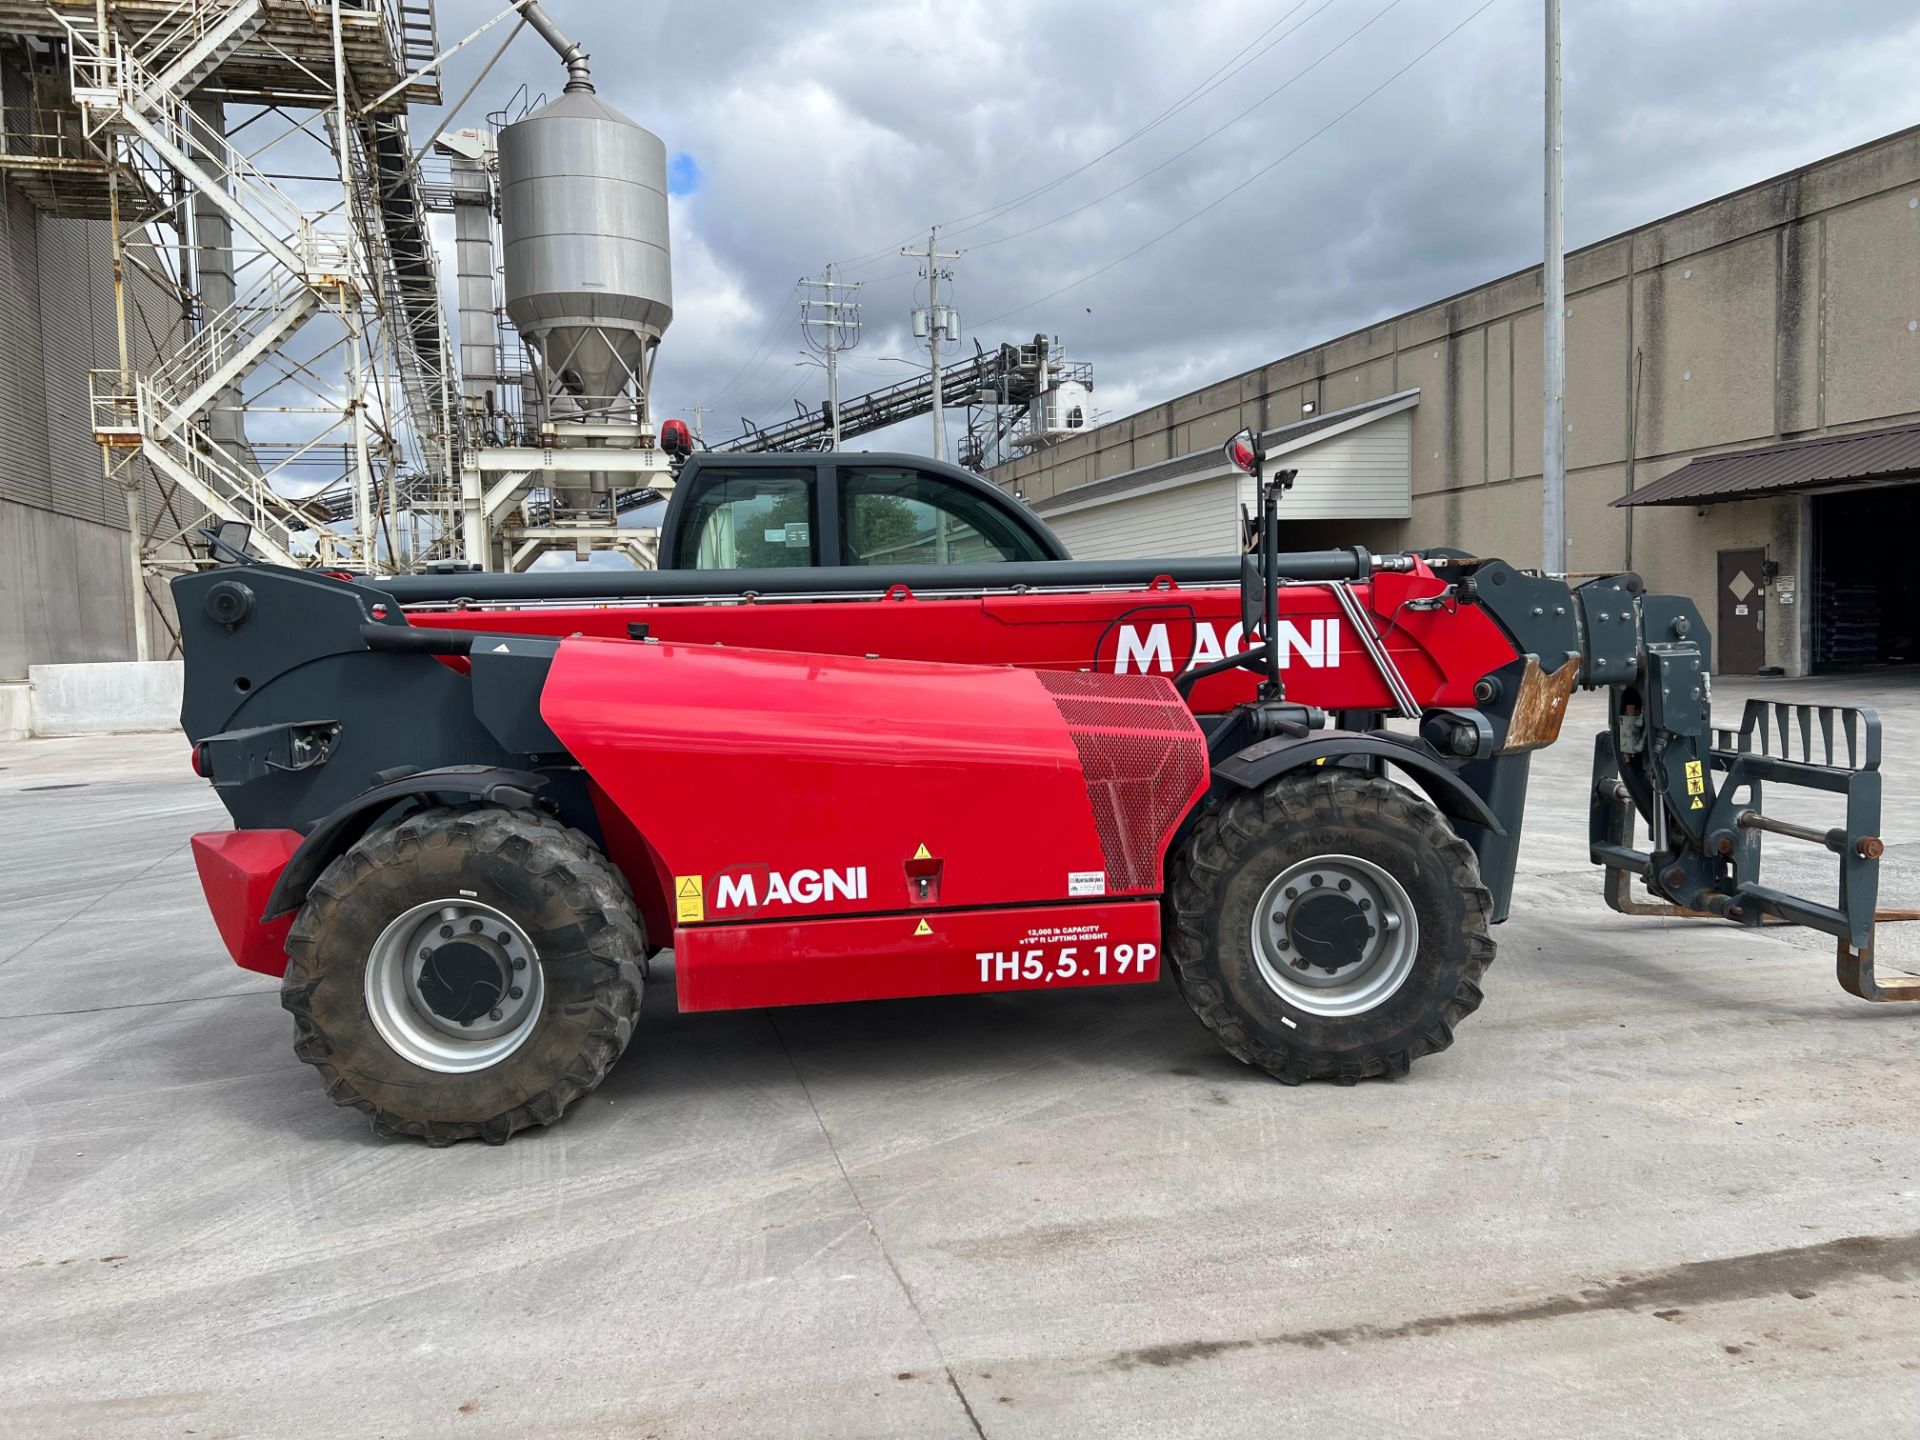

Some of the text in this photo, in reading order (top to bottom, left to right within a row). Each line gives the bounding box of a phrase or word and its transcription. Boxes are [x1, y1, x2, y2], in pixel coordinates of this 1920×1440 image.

[1113, 618, 1340, 675] MAGNI
[716, 866, 868, 908] MAGNI
[1027, 928, 1052, 936] 12,000
[1062, 925, 1100, 933] CAPACITY
[1047, 934, 1078, 942] LIFTING
[1079, 932, 1108, 940] HEIGHT
[976, 944, 1157, 982] TH5,5.19P
